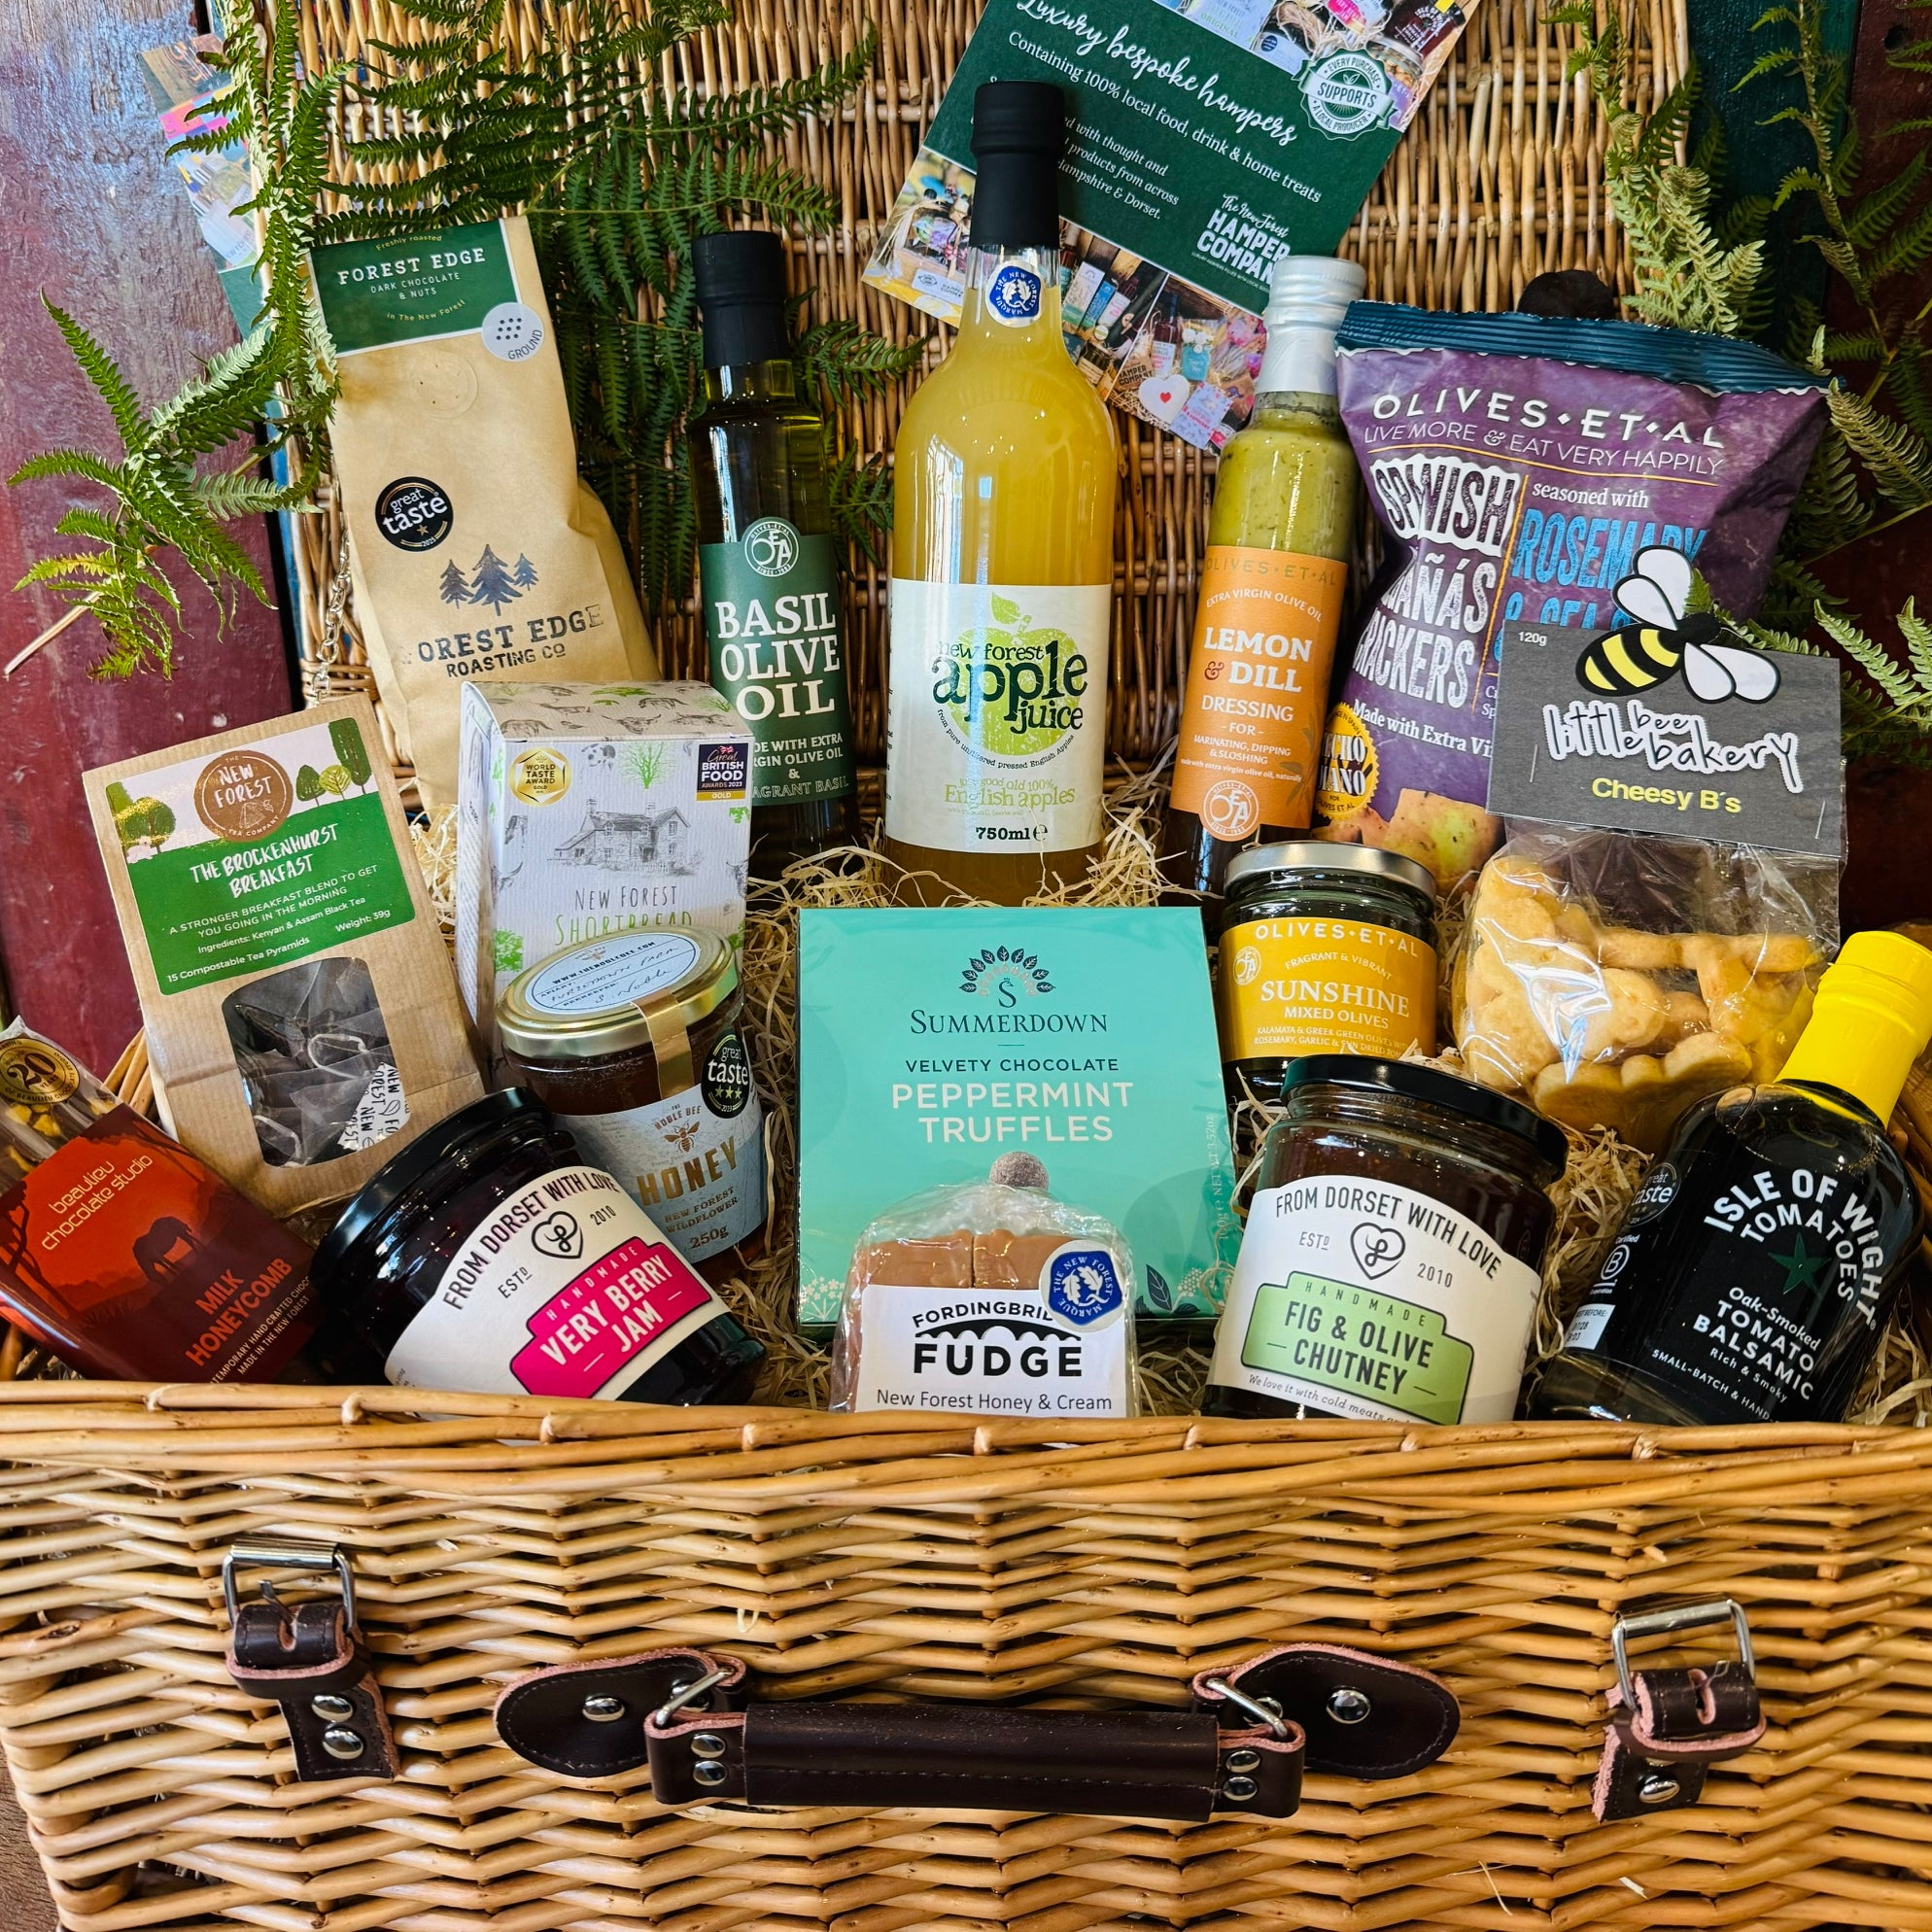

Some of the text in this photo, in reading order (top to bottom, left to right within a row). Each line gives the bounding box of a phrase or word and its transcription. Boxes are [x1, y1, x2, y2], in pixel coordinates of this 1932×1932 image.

[1017, 0, 1297, 146] Luxury bespoke hampers
[1328, 57, 1380, 88] EVERY PURCHASE
[1317, 82, 1377, 108] SUPPORTS
[1009, 32, 1322, 202] Containing 100% local food, drink & home treats
[1077, 123, 1168, 177] with thought and
[1068, 144, 1180, 205] products from across
[375, 237, 407, 251] Freshly
[1207, 209, 1291, 261] HAMPER
[337, 248, 486, 286] FOREST EDGE
[370, 272, 461, 293] DARK CHOCOLATE
[411, 288, 437, 297] NUTS
[507, 329, 542, 360] GROUND
[1363, 422, 1725, 476] LIVE MORE & EAT VERY HAPPILY
[391, 488, 425, 514] great
[1532, 481, 1649, 508] seasoned with
[383, 497, 447, 534] taste
[715, 593, 836, 638] BASIL
[1206, 589, 1322, 622] EXTRA VIRGIN OLIVE OIL
[938, 641, 1044, 660] new forest
[1204, 627, 1313, 662] LEMON
[1518, 632, 1547, 646] 120g
[446, 649, 536, 677] ROASTING
[720, 634, 840, 681] OLIVE
[932, 640, 1088, 721] apple
[1205, 661, 1301, 693] & DILL
[737, 680, 835, 721] OIL
[1010, 700, 1083, 735] juice
[1201, 695, 1294, 722] DRESSING
[1632, 706, 1689, 730] bee
[1353, 699, 1467, 751] Made with Extra
[707, 750, 738, 762] Great
[1547, 705, 1799, 788] little bakery
[219, 764, 254, 784] NEW
[701, 771, 743, 782] FOOD
[702, 761, 743, 771] BRITISH
[214, 777, 272, 810] FOREST
[944, 784, 1075, 812] English apples
[1592, 778, 1693, 812] Cheesy
[976, 827, 1030, 841] 750ml
[190, 823, 339, 884] THE BROCKENHURST
[229, 854, 314, 900] BREAKFAST
[179, 912, 239, 933] STRONGER
[241, 891, 302, 918] BREAKFAST
[304, 880, 339, 895] BLEND
[341, 875, 356, 884] TO
[358, 865, 378, 880] GET
[198, 927, 222, 938] YOU
[224, 916, 259, 934] GOING
[275, 905, 296, 919] THE
[297, 887, 348, 910] MORNING
[575, 885, 677, 911] NEW FOREST
[334, 909, 391, 934] Weight: 39g
[167, 937, 310, 983] 15 Compostable Tea Pyramids
[1285, 952, 1337, 970] FRAGRANT
[1352, 955, 1393, 980] VIBRANT
[1260, 980, 1410, 1018] SUNSHINE
[1284, 1007, 1389, 1029] MIXED OLIVES
[707, 1059, 748, 1086] taste
[905, 1058, 1120, 1073] VELVETY CHOCOLATE
[891, 1082, 1133, 1109] PEPPERMINT
[918, 1115, 1114, 1143] TRUFFLES
[49, 1160, 116, 1214] beaulieu
[637, 1137, 737, 1207] HONEY
[41, 1155, 153, 1251] chocolate studio
[590, 1205, 615, 1226] 2010
[665, 1187, 735, 1223] NEW FOREST
[665, 1197, 739, 1233] WILDFLOWER
[443, 1172, 620, 1310] FROM DORSET WITH LOVE
[690, 1225, 729, 1249] 250g
[1276, 1187, 1502, 1281] FROM DORSET WITH LOVE
[1704, 1169, 1883, 1325] ISLE OF WIGHT
[1740, 1203, 1856, 1301] TOMATOES
[194, 1269, 244, 1315] MILK
[545, 1247, 639, 1322] HANDMADE
[1417, 1263, 1454, 1288] 2010
[185, 1258, 293, 1366] HONEYCOMB
[539, 1255, 673, 1366] VERY BERRY
[1305, 1282, 1427, 1327] HANDMADE
[1729, 1287, 1821, 1351] Oak-Smoked
[237, 1295, 310, 1374] MADE IN THE NEW FOREST
[610, 1299, 664, 1353] JAM
[1285, 1301, 1434, 1368] FIG & OLIVE
[1717, 1299, 1814, 1373] TOMATO
[913, 1343, 1082, 1377] FUDGE
[1294, 1338, 1407, 1395] CHUTNEY
[1693, 1315, 1813, 1400] BALSAMIC
[1709, 1348, 1788, 1403] Rich & Smoky
[877, 1390, 1112, 1413] New Forest Honey & Cream
